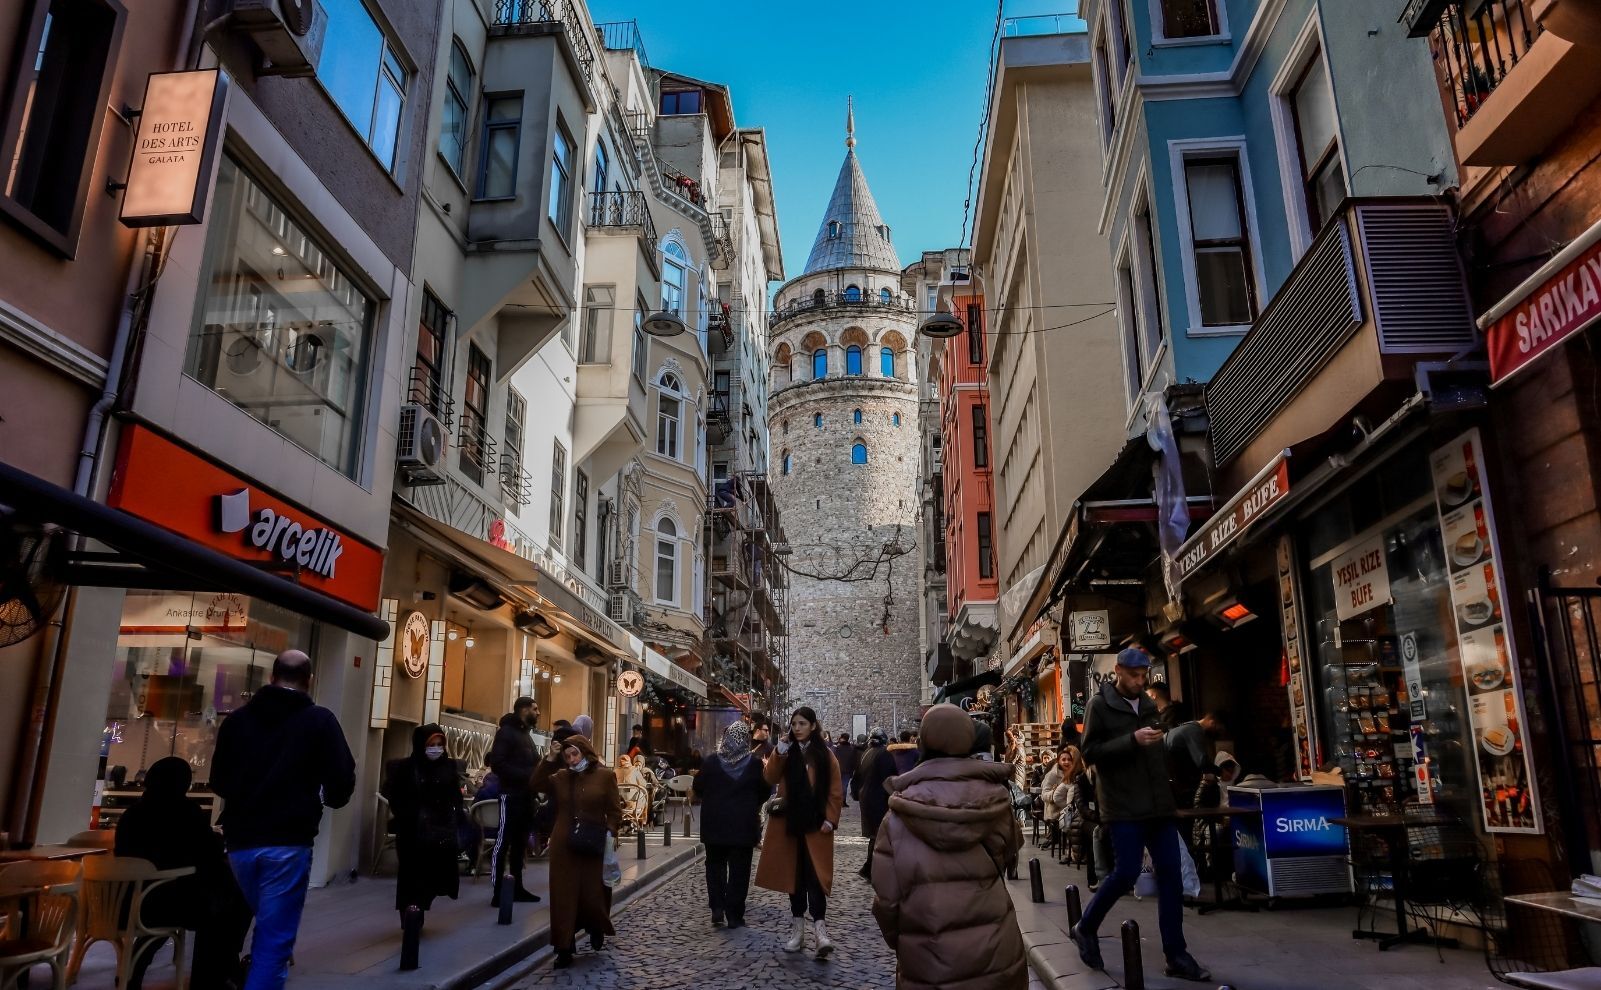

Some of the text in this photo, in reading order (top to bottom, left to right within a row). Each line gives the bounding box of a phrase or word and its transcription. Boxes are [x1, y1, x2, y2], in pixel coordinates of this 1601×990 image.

[152, 121, 194, 134] HOTEL
[141, 135, 200, 149] DES ARTS
[148, 155, 185, 164] GALATA
[1209, 512, 1238, 550] RİZE
[1242, 474, 1280, 522] BÜFE
[1360, 548, 1381, 576] RİZE
[1351, 582, 1373, 609] BÜFE
[166, 607, 204, 618] Ankastre
[1275, 816, 1331, 833] SIRMA
